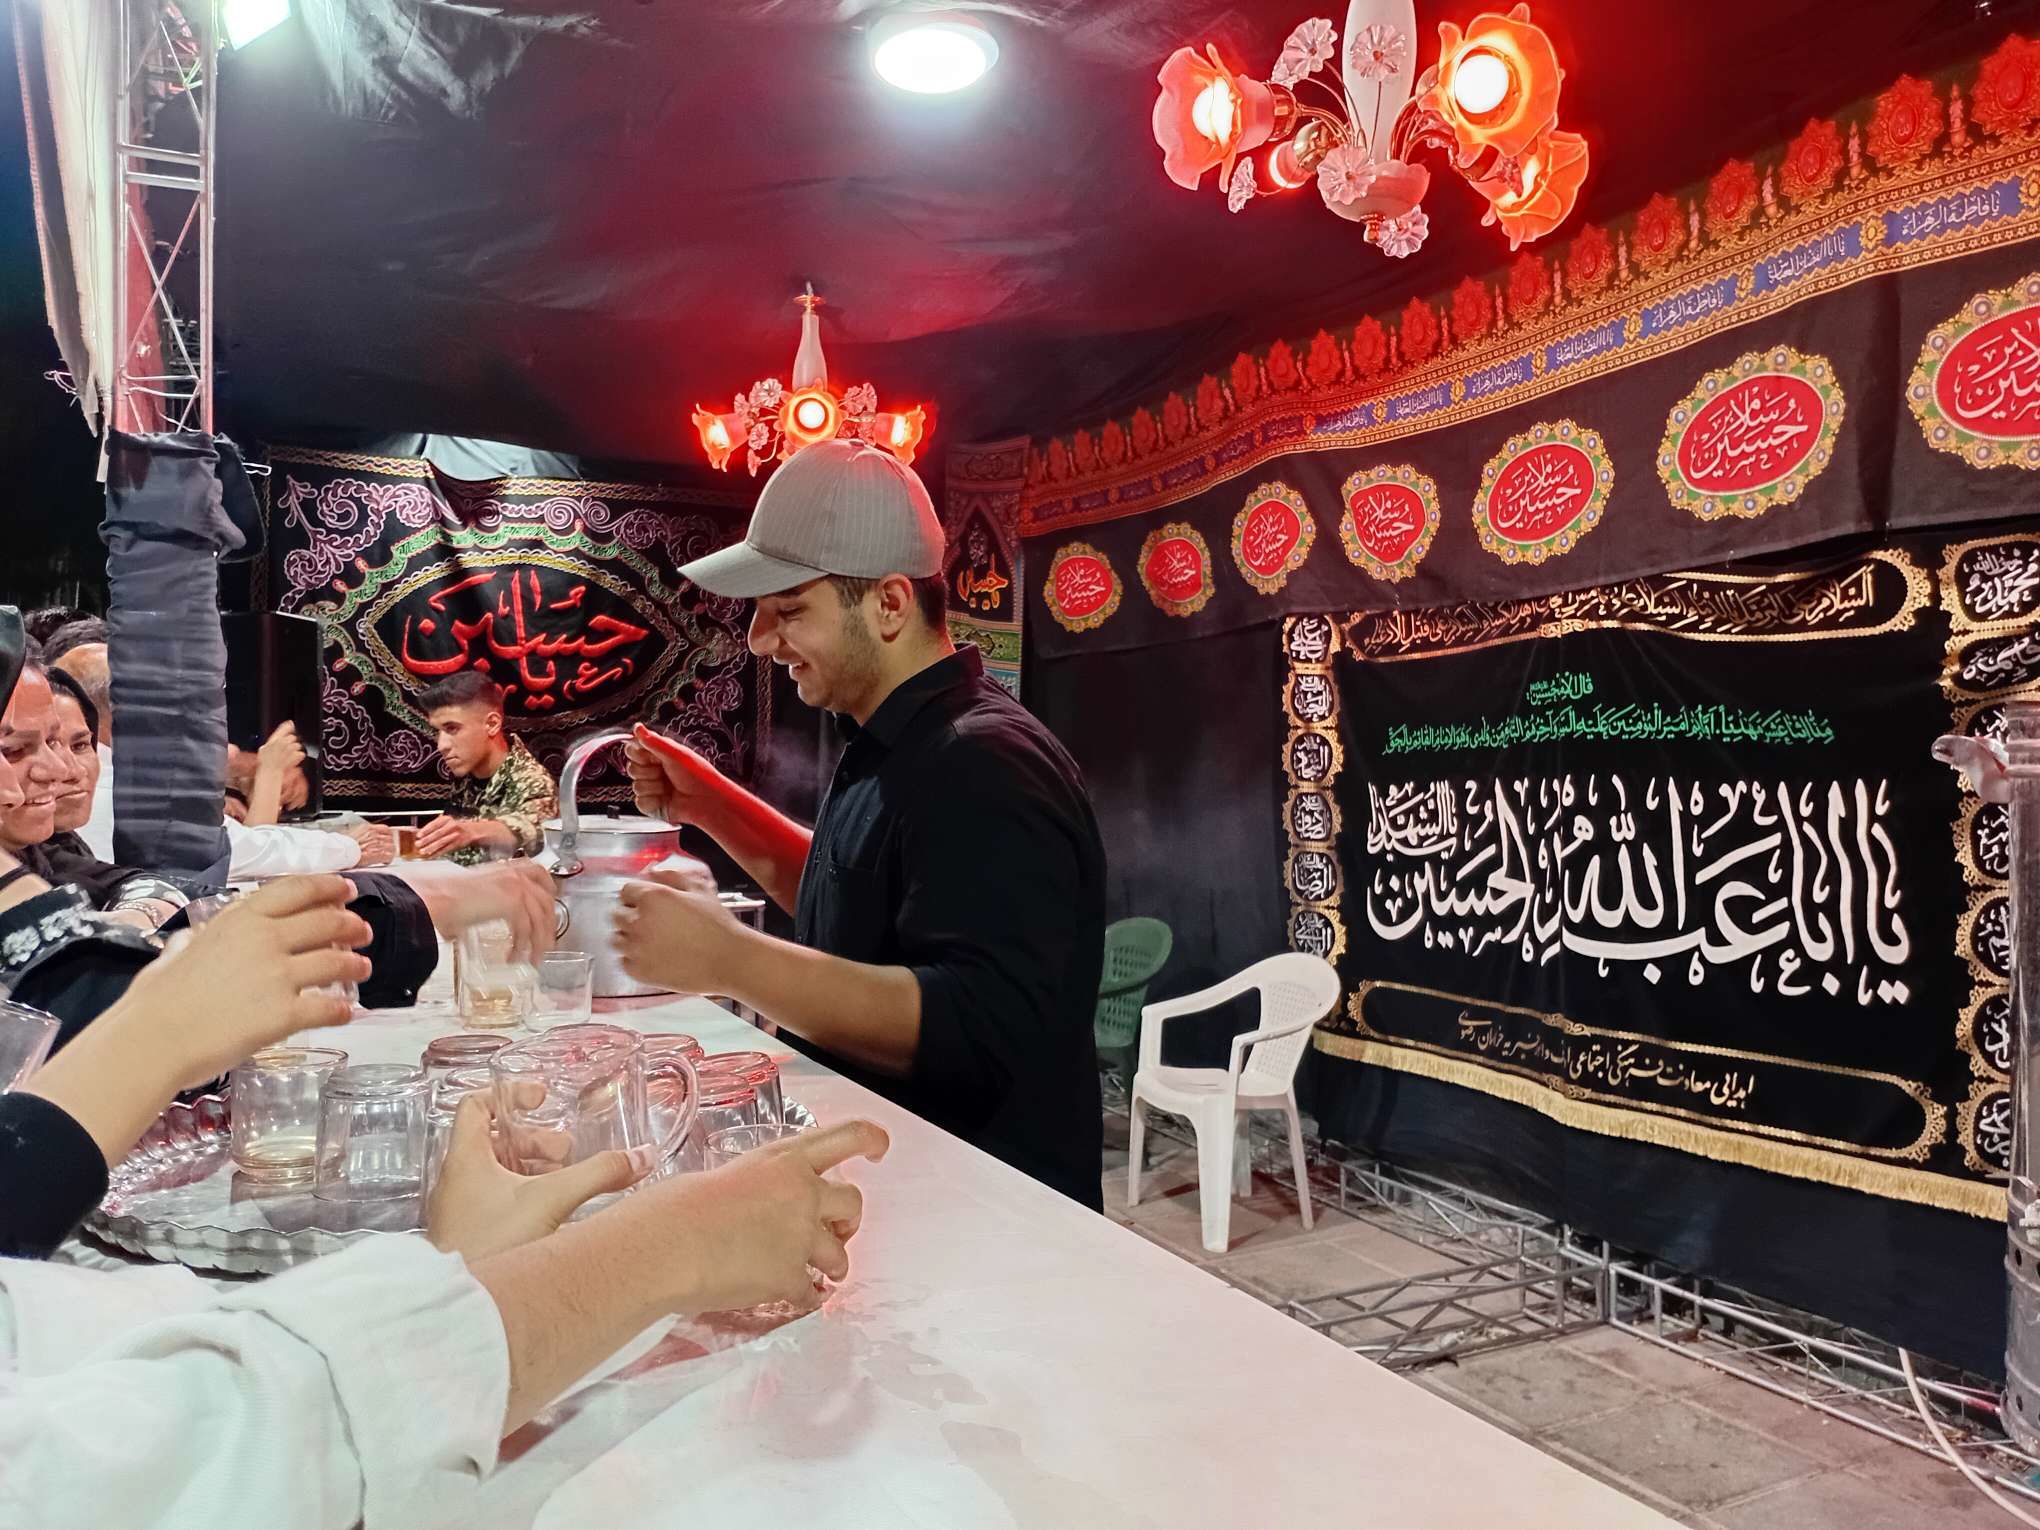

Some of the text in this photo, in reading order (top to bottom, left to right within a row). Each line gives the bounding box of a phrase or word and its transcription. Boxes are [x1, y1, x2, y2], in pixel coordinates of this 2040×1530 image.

[1690, 422, 1809, 479] حسین
[1498, 485, 1582, 529] حسین
[1364, 517, 1416, 548] حسین
[1807, 563, 1875, 622] السلام
[401, 600, 649, 677] حسین
[1569, 671, 1594, 700] قال
[1366, 777, 1535, 950] الحسین
[1569, 1044, 1610, 1080] اجتماعی
[1608, 1044, 1665, 1087] فرهنگی
[1657, 1063, 1711, 1094] معاونت
